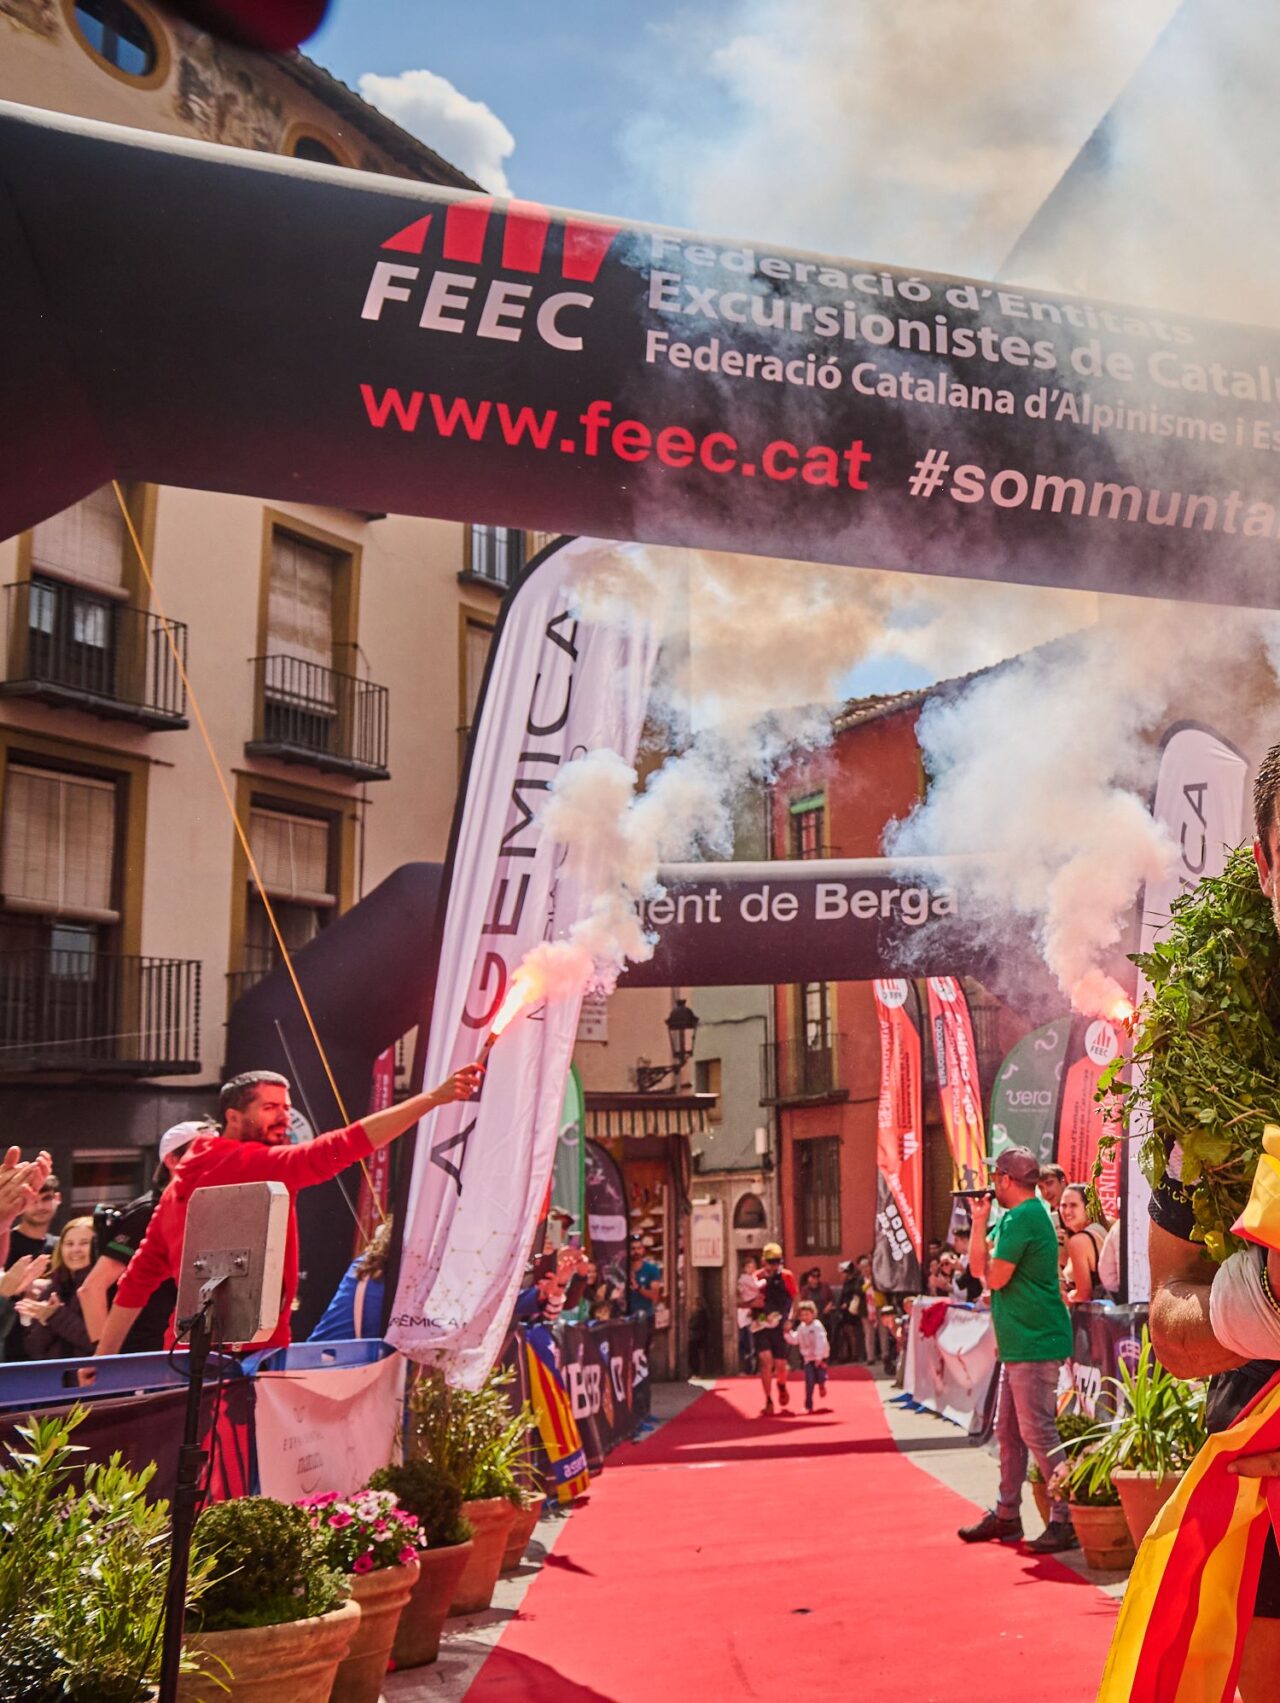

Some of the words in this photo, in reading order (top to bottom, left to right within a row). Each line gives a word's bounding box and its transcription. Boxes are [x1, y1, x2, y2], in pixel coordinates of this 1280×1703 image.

[360, 260, 595, 352] FEEC
[647, 269, 1057, 372] Excursionistes
[1069, 340, 1136, 383] de
[648, 232, 932, 303] Federació
[944, 283, 1196, 345] d'Entitats
[359, 382, 872, 491] www.feec.cat
[645, 328, 842, 391] Federació
[850, 361, 1016, 416] Catalana
[1023, 386, 1228, 446] d'Alpinisme
[1233, 417, 1246, 447] i
[739, 884, 799, 923] de
[814, 882, 960, 926] Berga
[1090, 1045, 1109, 1058] FEEC
